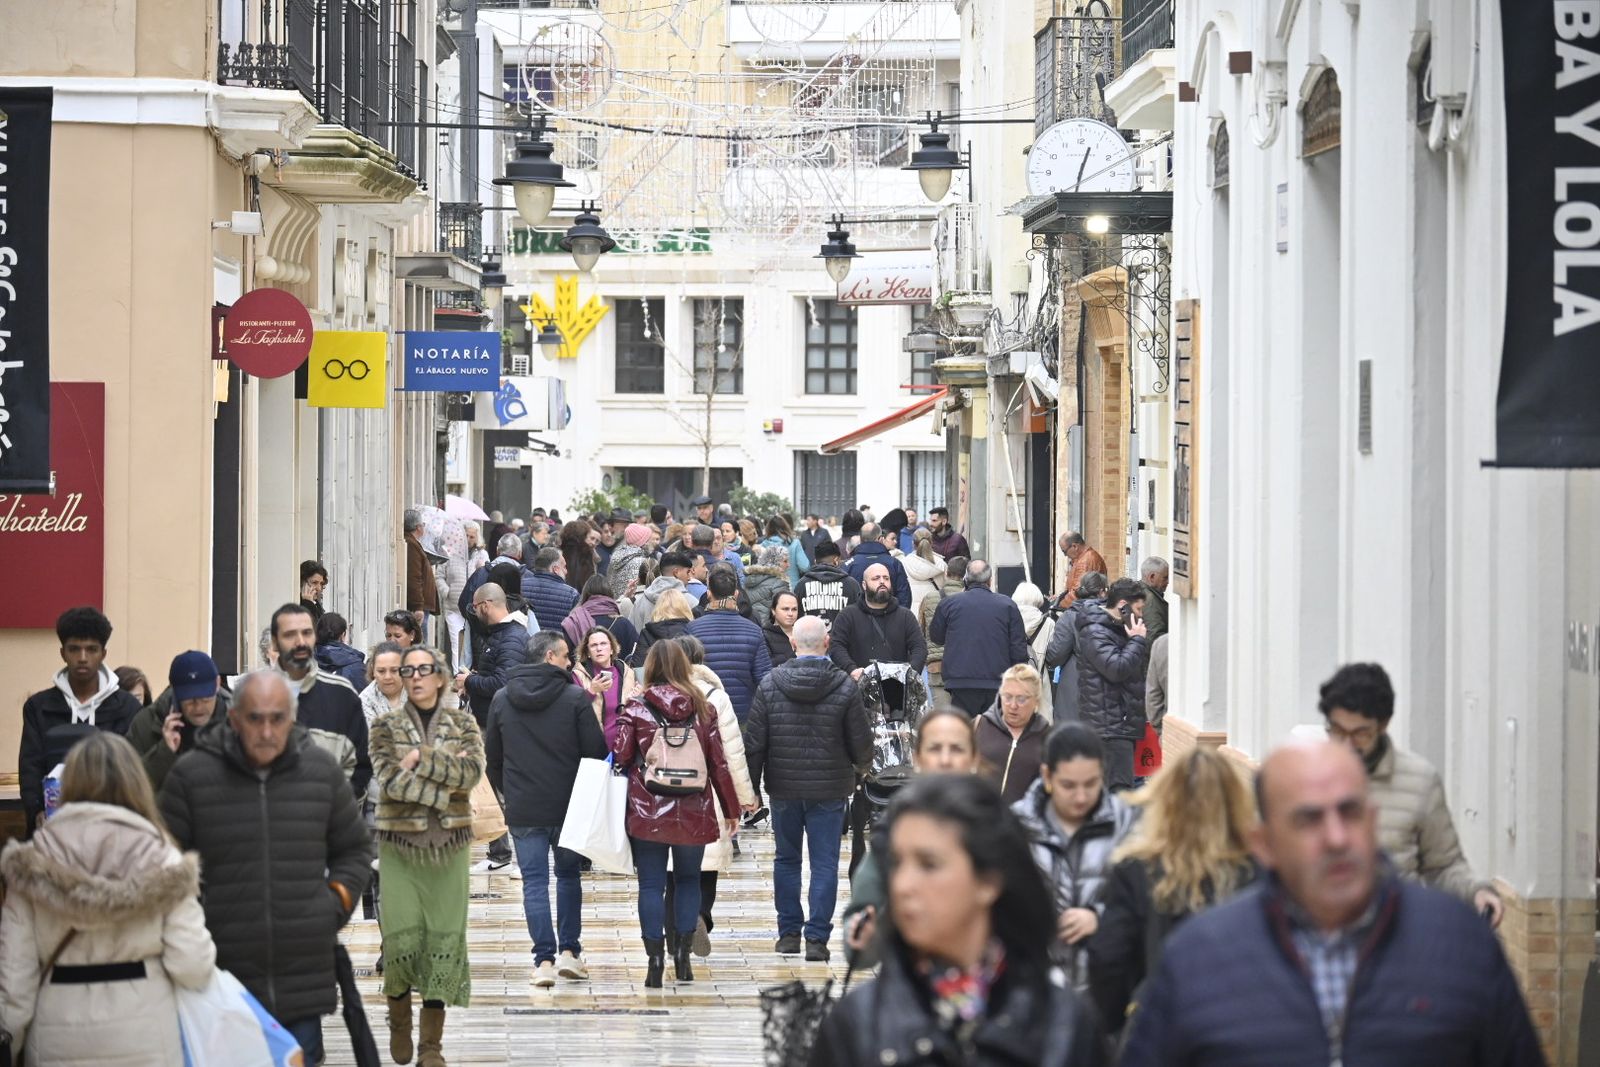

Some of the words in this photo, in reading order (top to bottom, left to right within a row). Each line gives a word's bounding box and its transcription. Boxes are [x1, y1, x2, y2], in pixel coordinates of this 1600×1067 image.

[1553, 100, 1600, 147] Y
[1554, 167, 1600, 336] LOLA
[231, 329, 251, 344] La
[251, 329, 306, 346] Tagliatella
[414, 346, 490, 360] NOTARÍA
[426, 366, 457, 375] ÁBALOS
[460, 367, 489, 375] NUEVO
[0, 492, 88, 533] liatella
[805, 581, 843, 597] BUILDING
[802, 595, 848, 612] COMMUNITY
